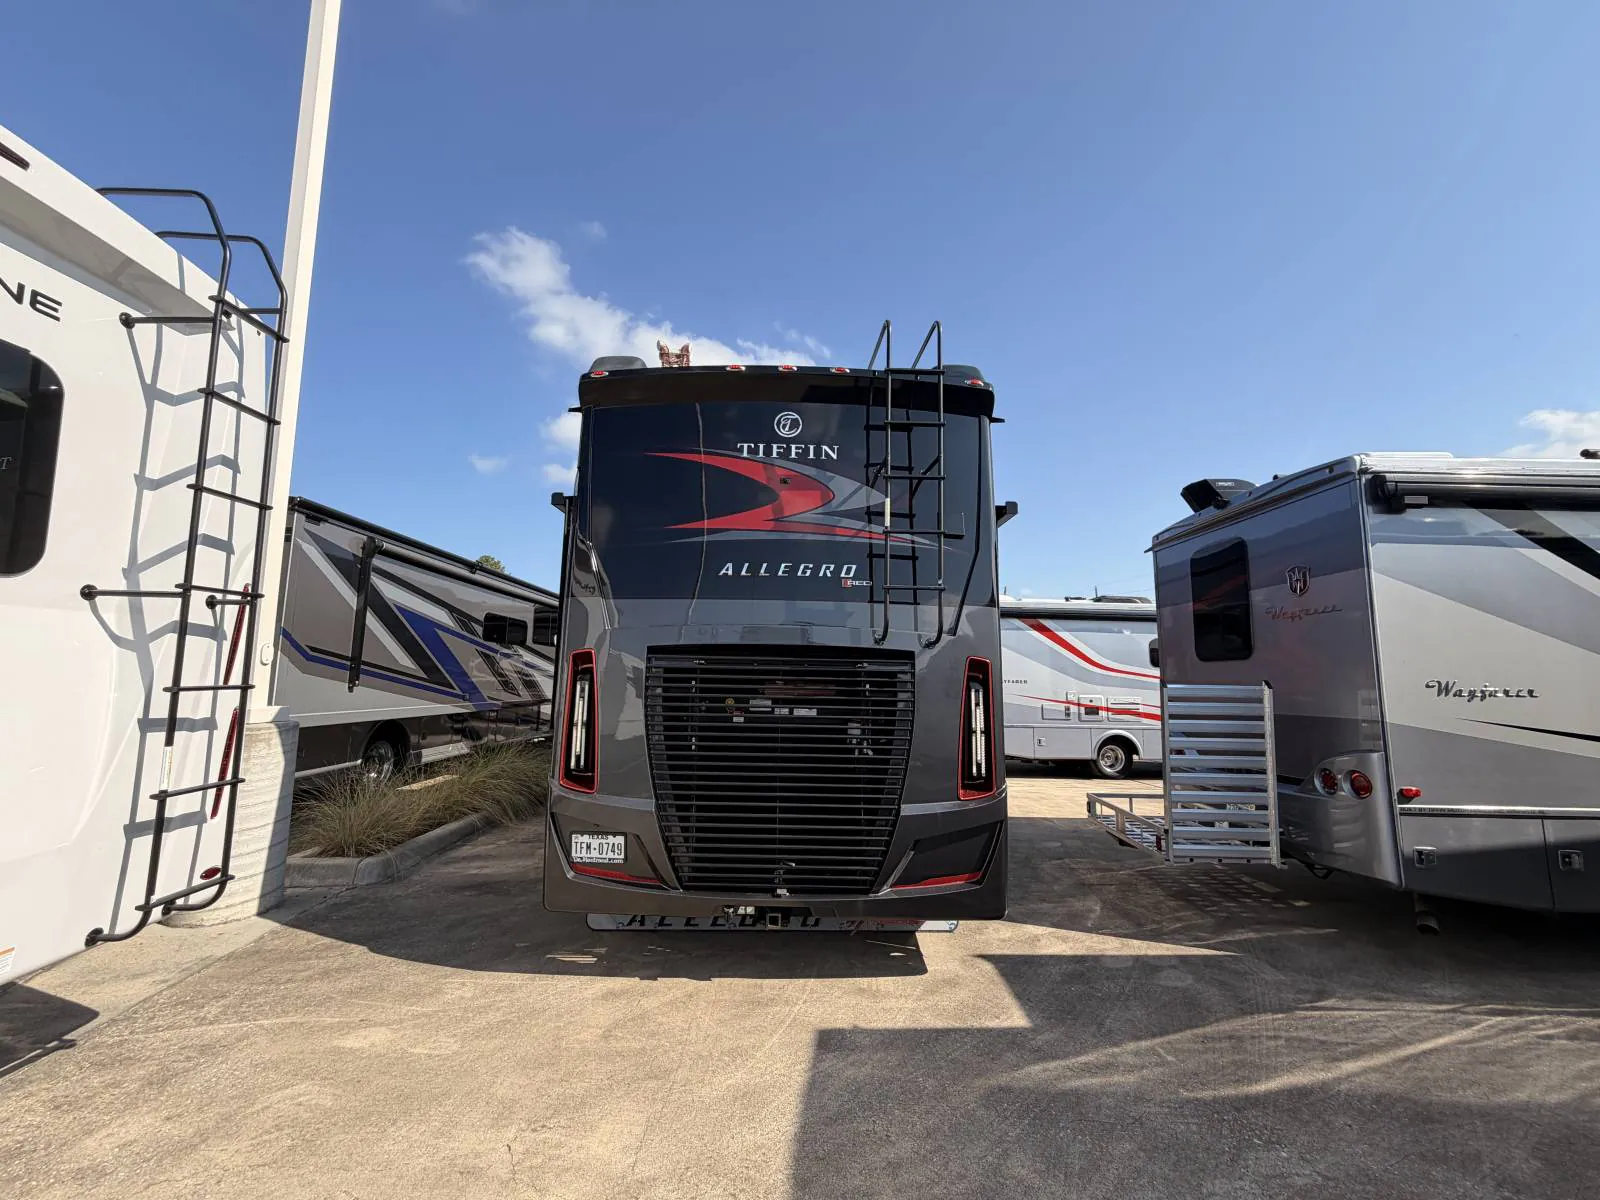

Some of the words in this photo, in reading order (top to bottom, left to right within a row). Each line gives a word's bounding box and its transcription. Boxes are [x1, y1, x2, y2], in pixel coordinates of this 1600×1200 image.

[737, 443, 839, 460] TIFFIN
[718, 562, 857, 578] ALLEGRO
[1425, 680, 1540, 702] Wayfarer
